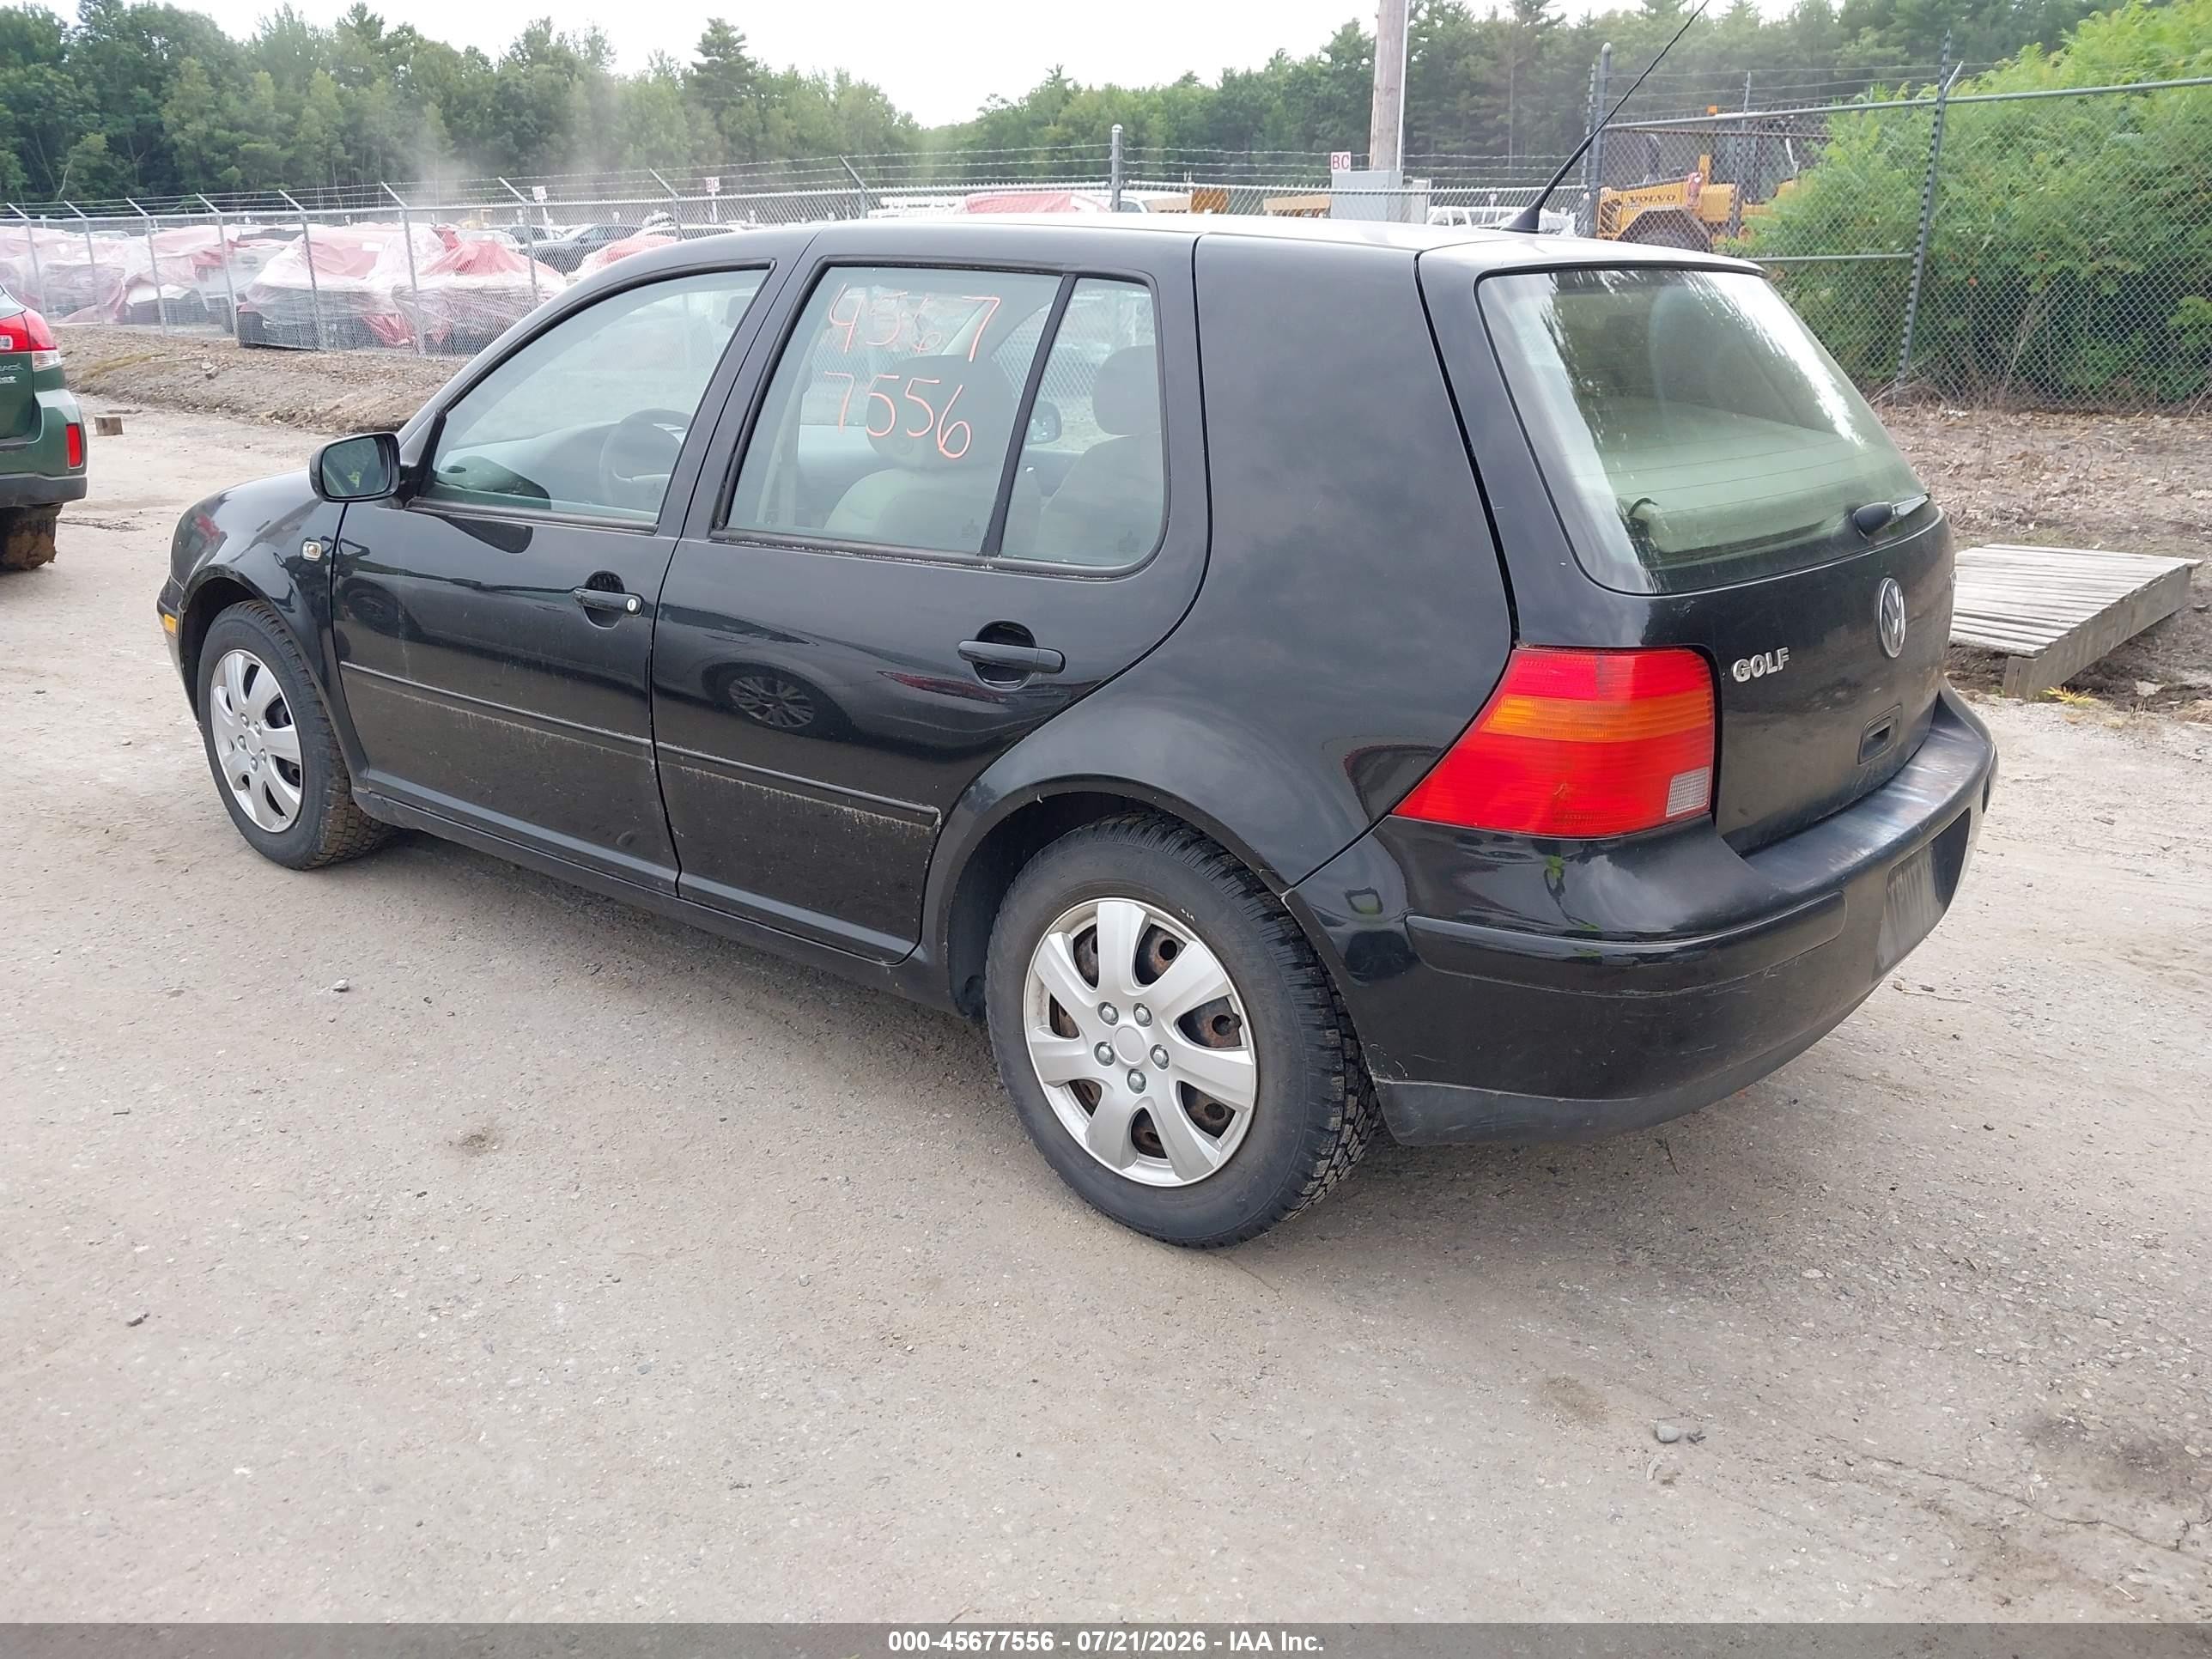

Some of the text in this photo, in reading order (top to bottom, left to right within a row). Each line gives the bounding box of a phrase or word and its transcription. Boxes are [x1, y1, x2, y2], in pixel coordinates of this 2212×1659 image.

[1332, 155, 1350, 170] BC
[1628, 194, 1676, 203] VOLVO
[823, 370, 972, 459] 7556
[1732, 647, 1790, 683] GOLF
